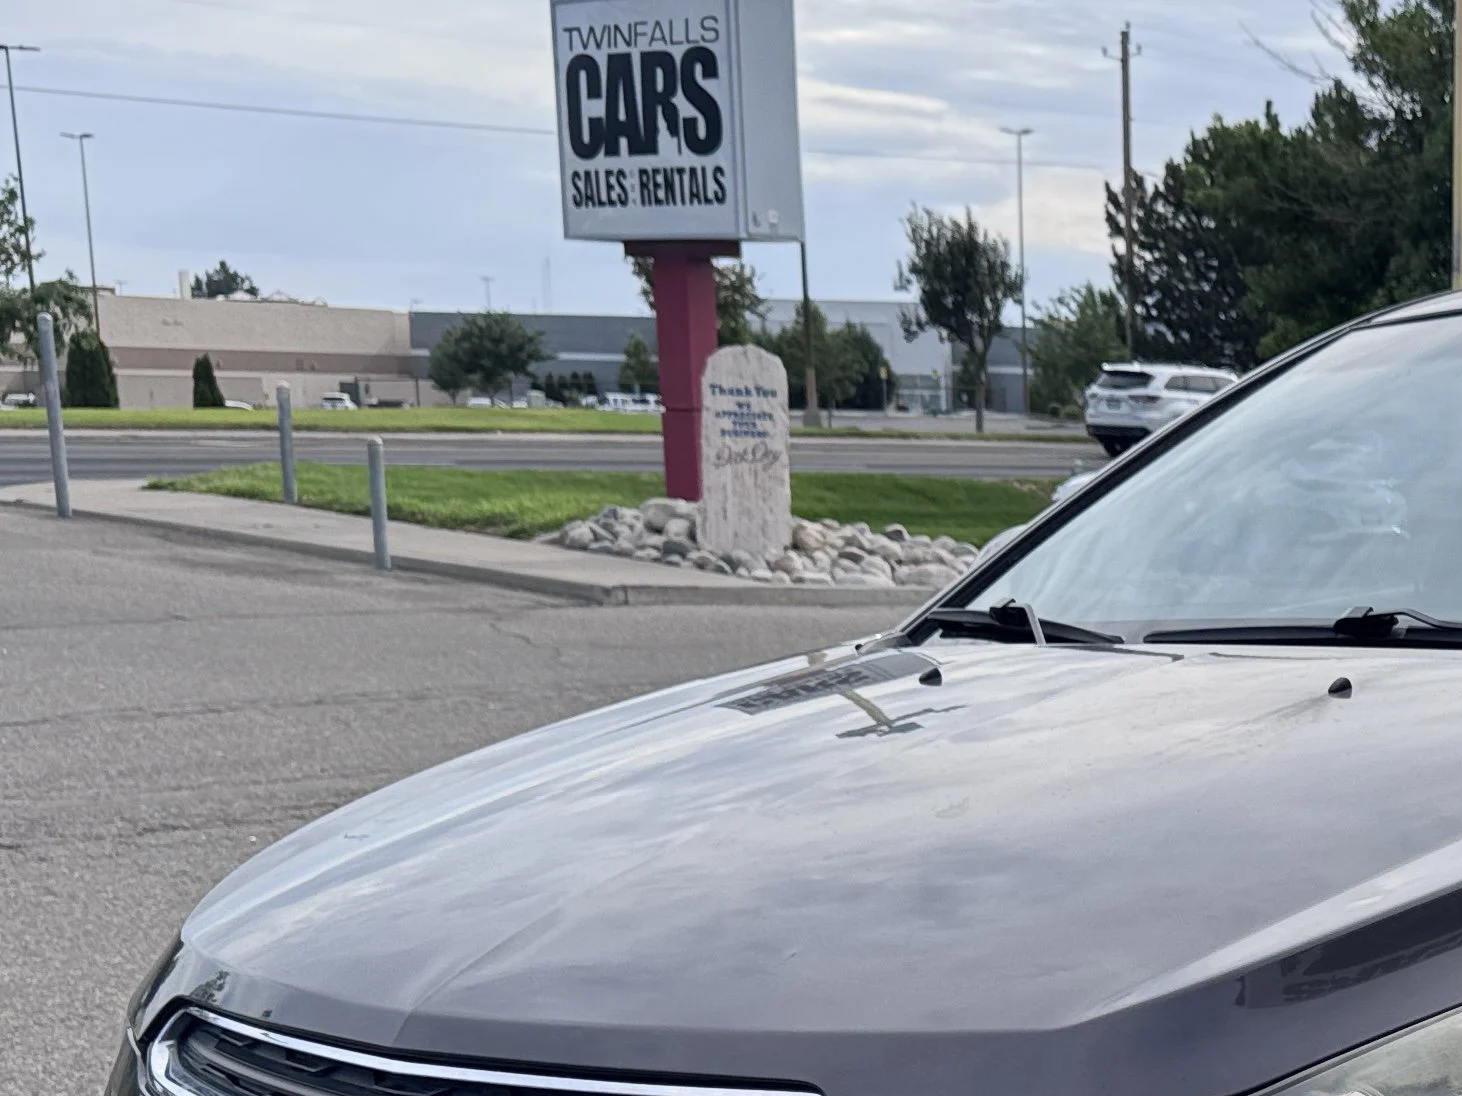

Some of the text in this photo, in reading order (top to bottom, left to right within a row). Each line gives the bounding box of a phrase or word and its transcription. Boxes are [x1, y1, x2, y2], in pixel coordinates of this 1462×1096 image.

[563, 15, 720, 51] TWINFALLS
[566, 46, 723, 161] CARS
[571, 168, 629, 209] SALES
[639, 165, 727, 208] RENTALS
[709, 383, 778, 398] Thank You
